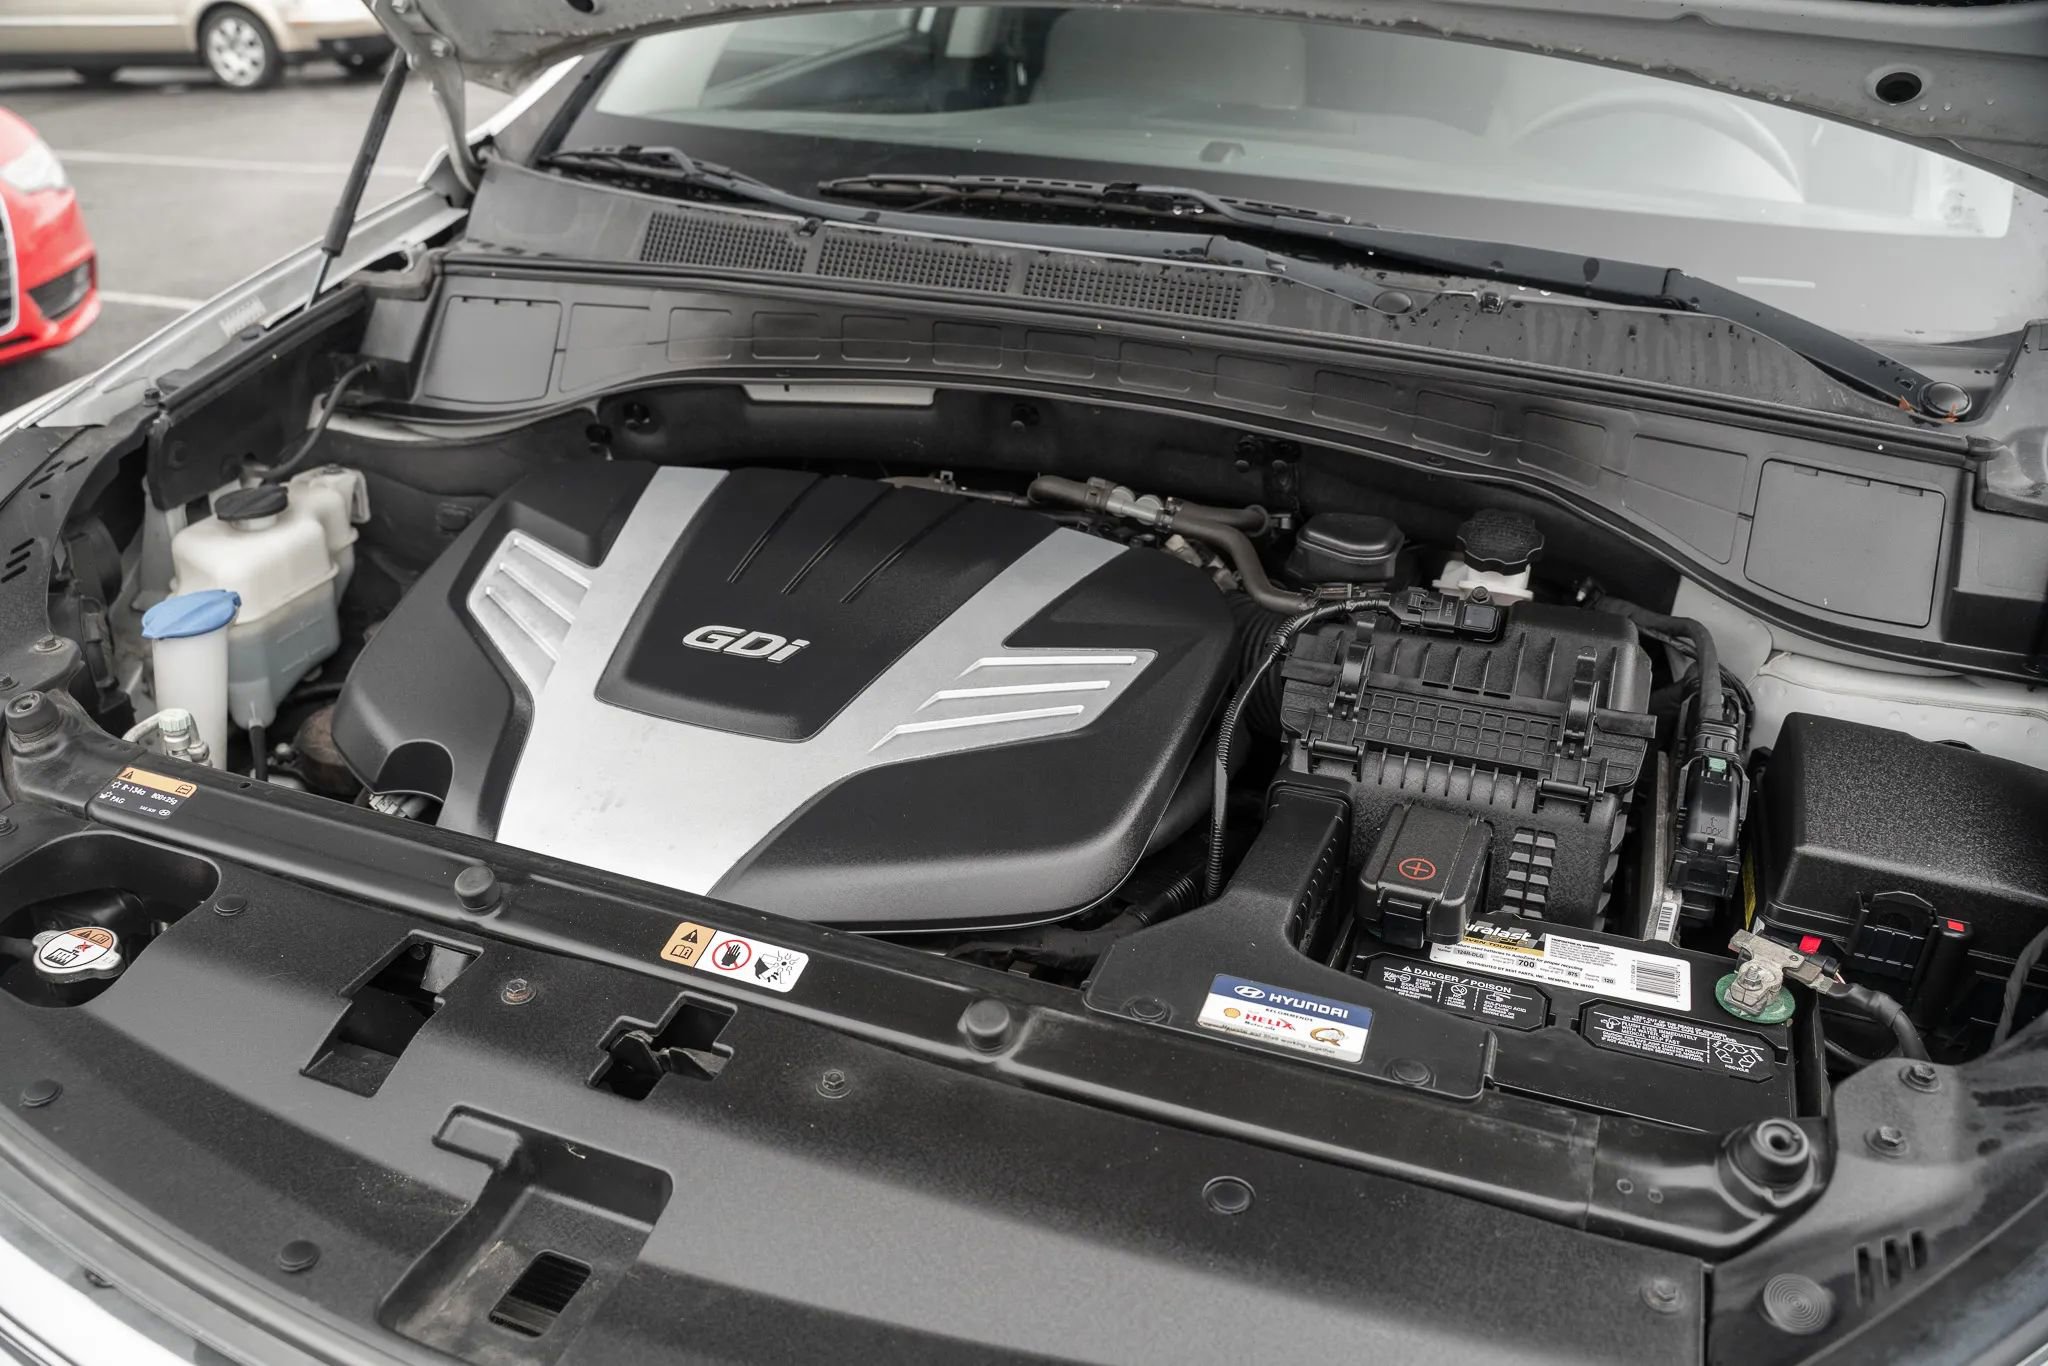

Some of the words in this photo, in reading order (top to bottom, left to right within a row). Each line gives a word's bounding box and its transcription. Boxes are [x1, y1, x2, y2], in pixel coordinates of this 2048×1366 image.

[682, 625, 810, 664] GDi
[110, 795, 126, 804] PAG
[1465, 922, 1532, 941] uralast
[1518, 959, 1535, 968] 700
[1414, 967, 1459, 984] DANGER
[1470, 980, 1512, 994] POISON
[1269, 993, 1349, 1019] HYUNDAI
[1659, 1029, 1698, 1041] IMMEDIATELY
[1724, 1064, 1750, 1073] RECYCLE
